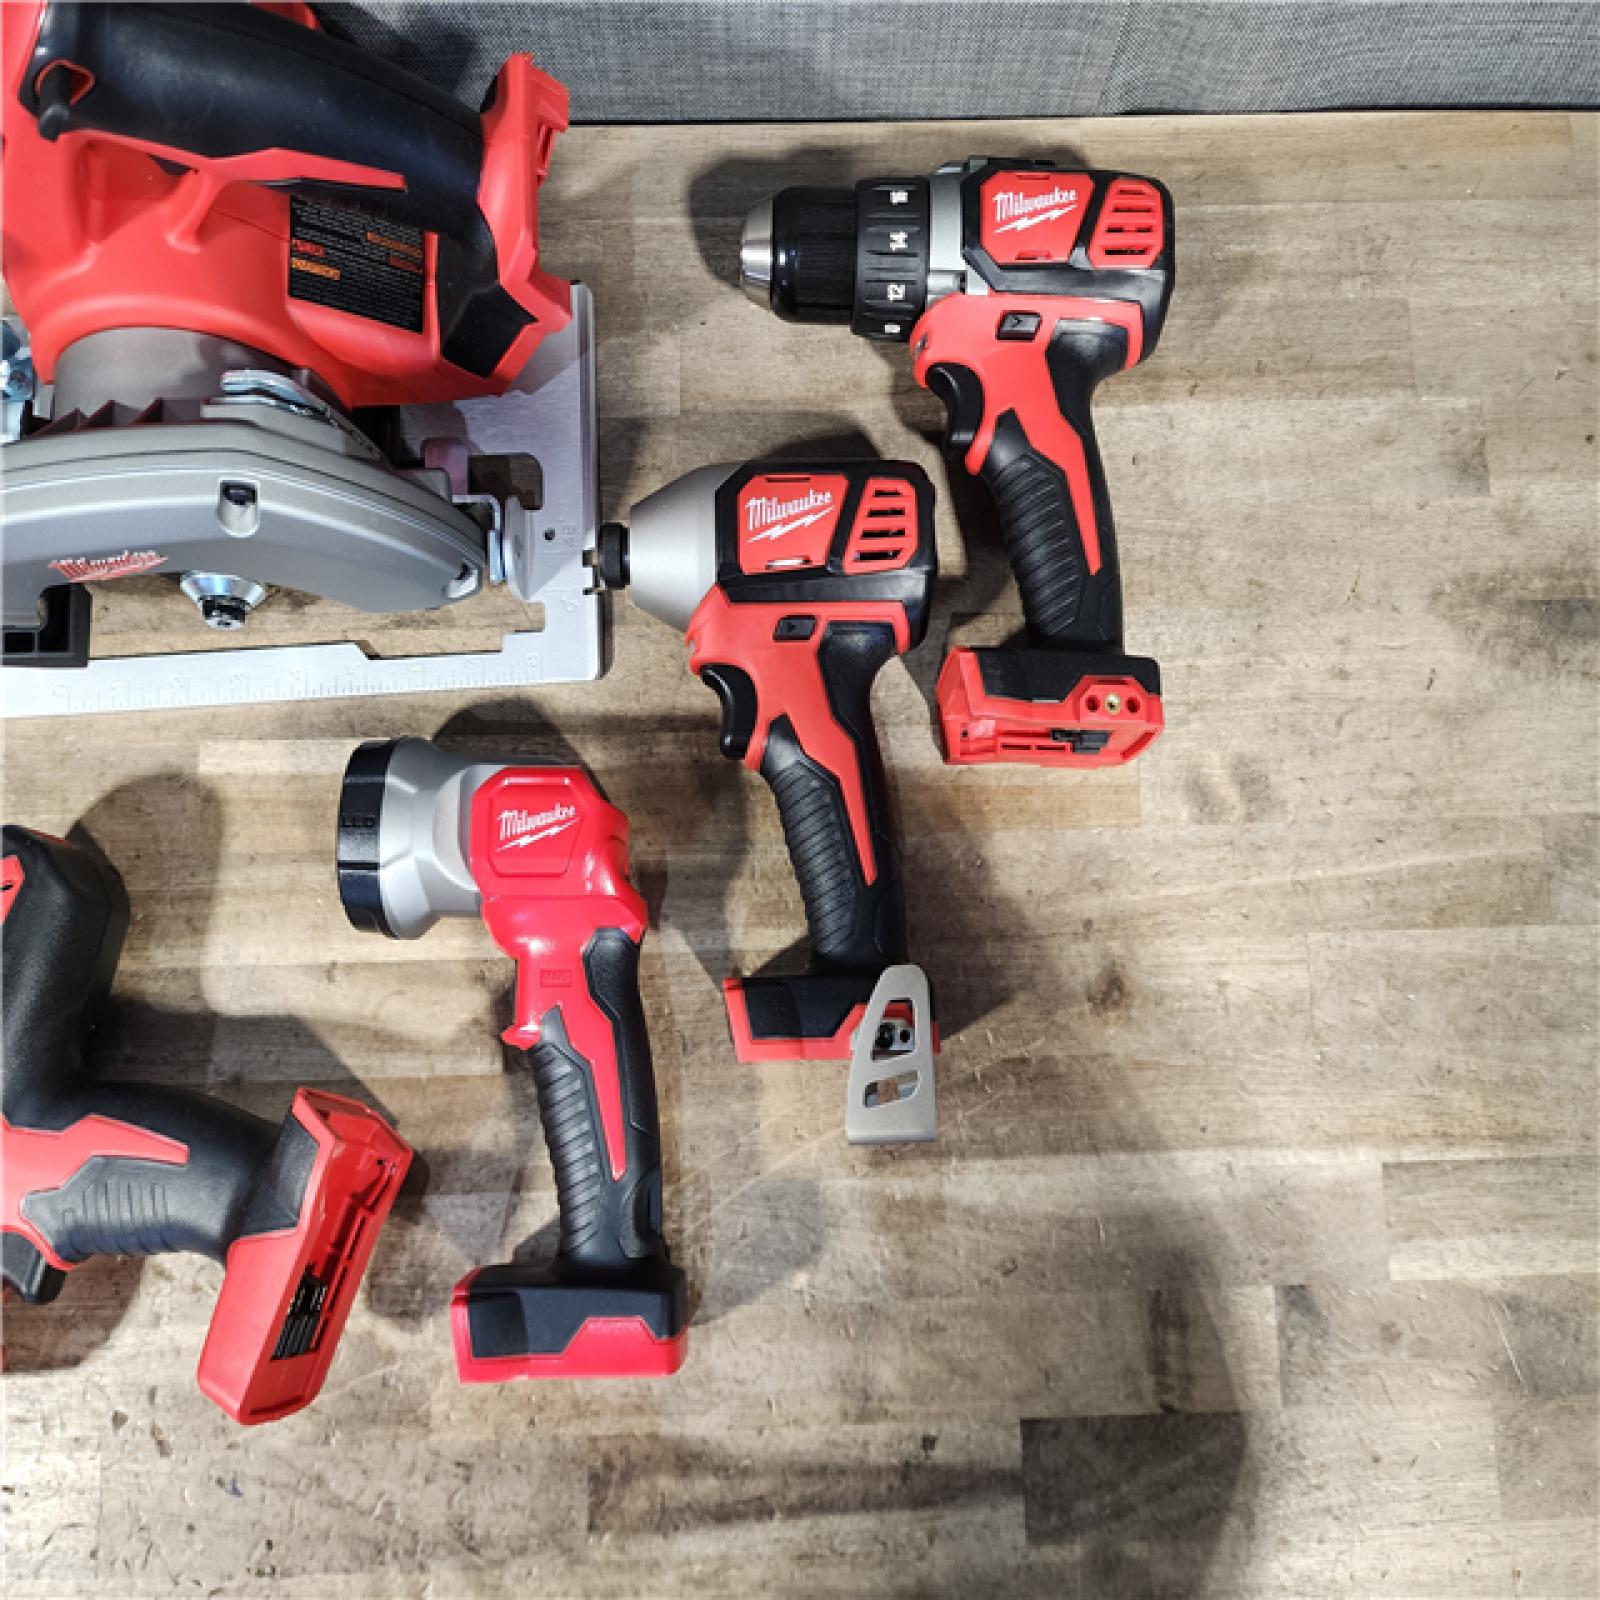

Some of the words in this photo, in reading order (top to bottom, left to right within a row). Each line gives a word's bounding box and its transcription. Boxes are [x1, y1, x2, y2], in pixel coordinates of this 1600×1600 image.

[992, 186, 1077, 223] Milwaukee
[890, 232, 908, 251] 14
[887, 284, 906, 303] 12
[745, 488, 831, 531] Milwaukee
[497, 802, 576, 840] Milwaukee
